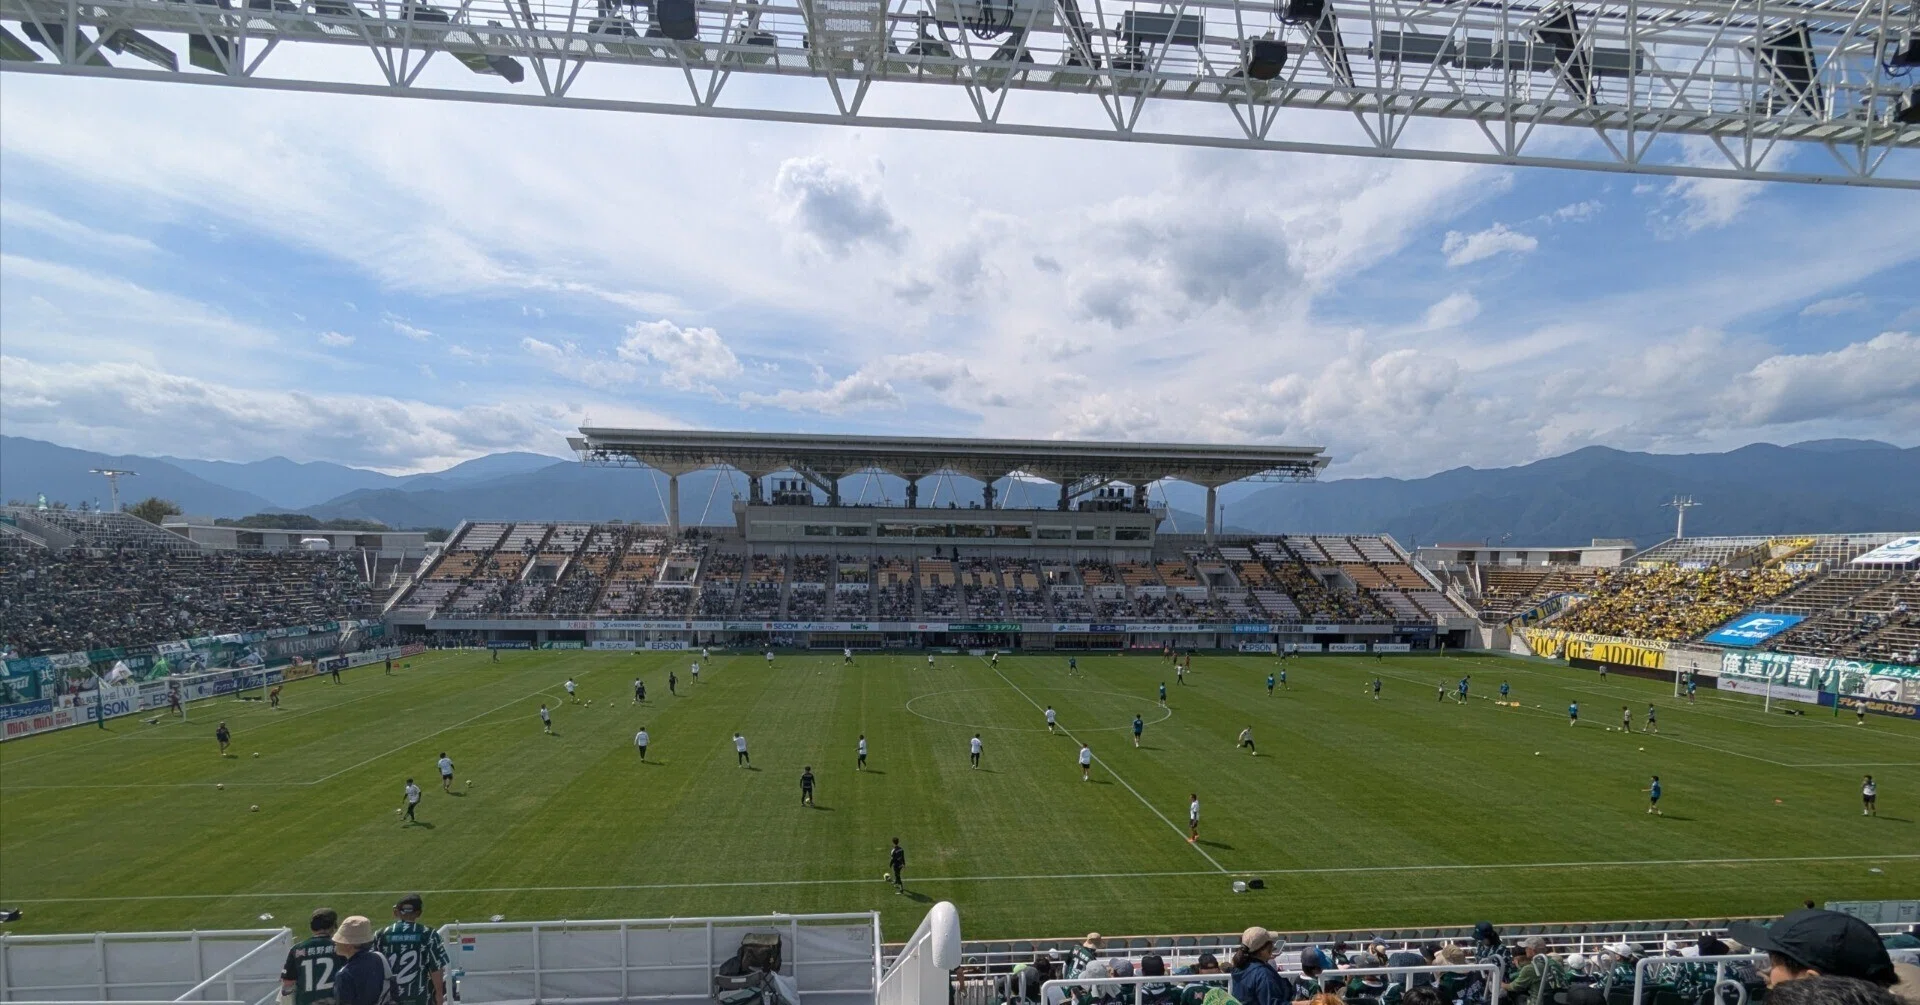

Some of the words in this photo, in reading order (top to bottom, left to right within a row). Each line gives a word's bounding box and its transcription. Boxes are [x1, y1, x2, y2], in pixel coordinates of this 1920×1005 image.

[280, 634, 338, 654] MATSUMOTO
[1600, 645, 1663, 668] ADDICT
[87, 700, 130, 720] ESON
[308, 945, 336, 956] 長野銀
[301, 957, 334, 992] 12
